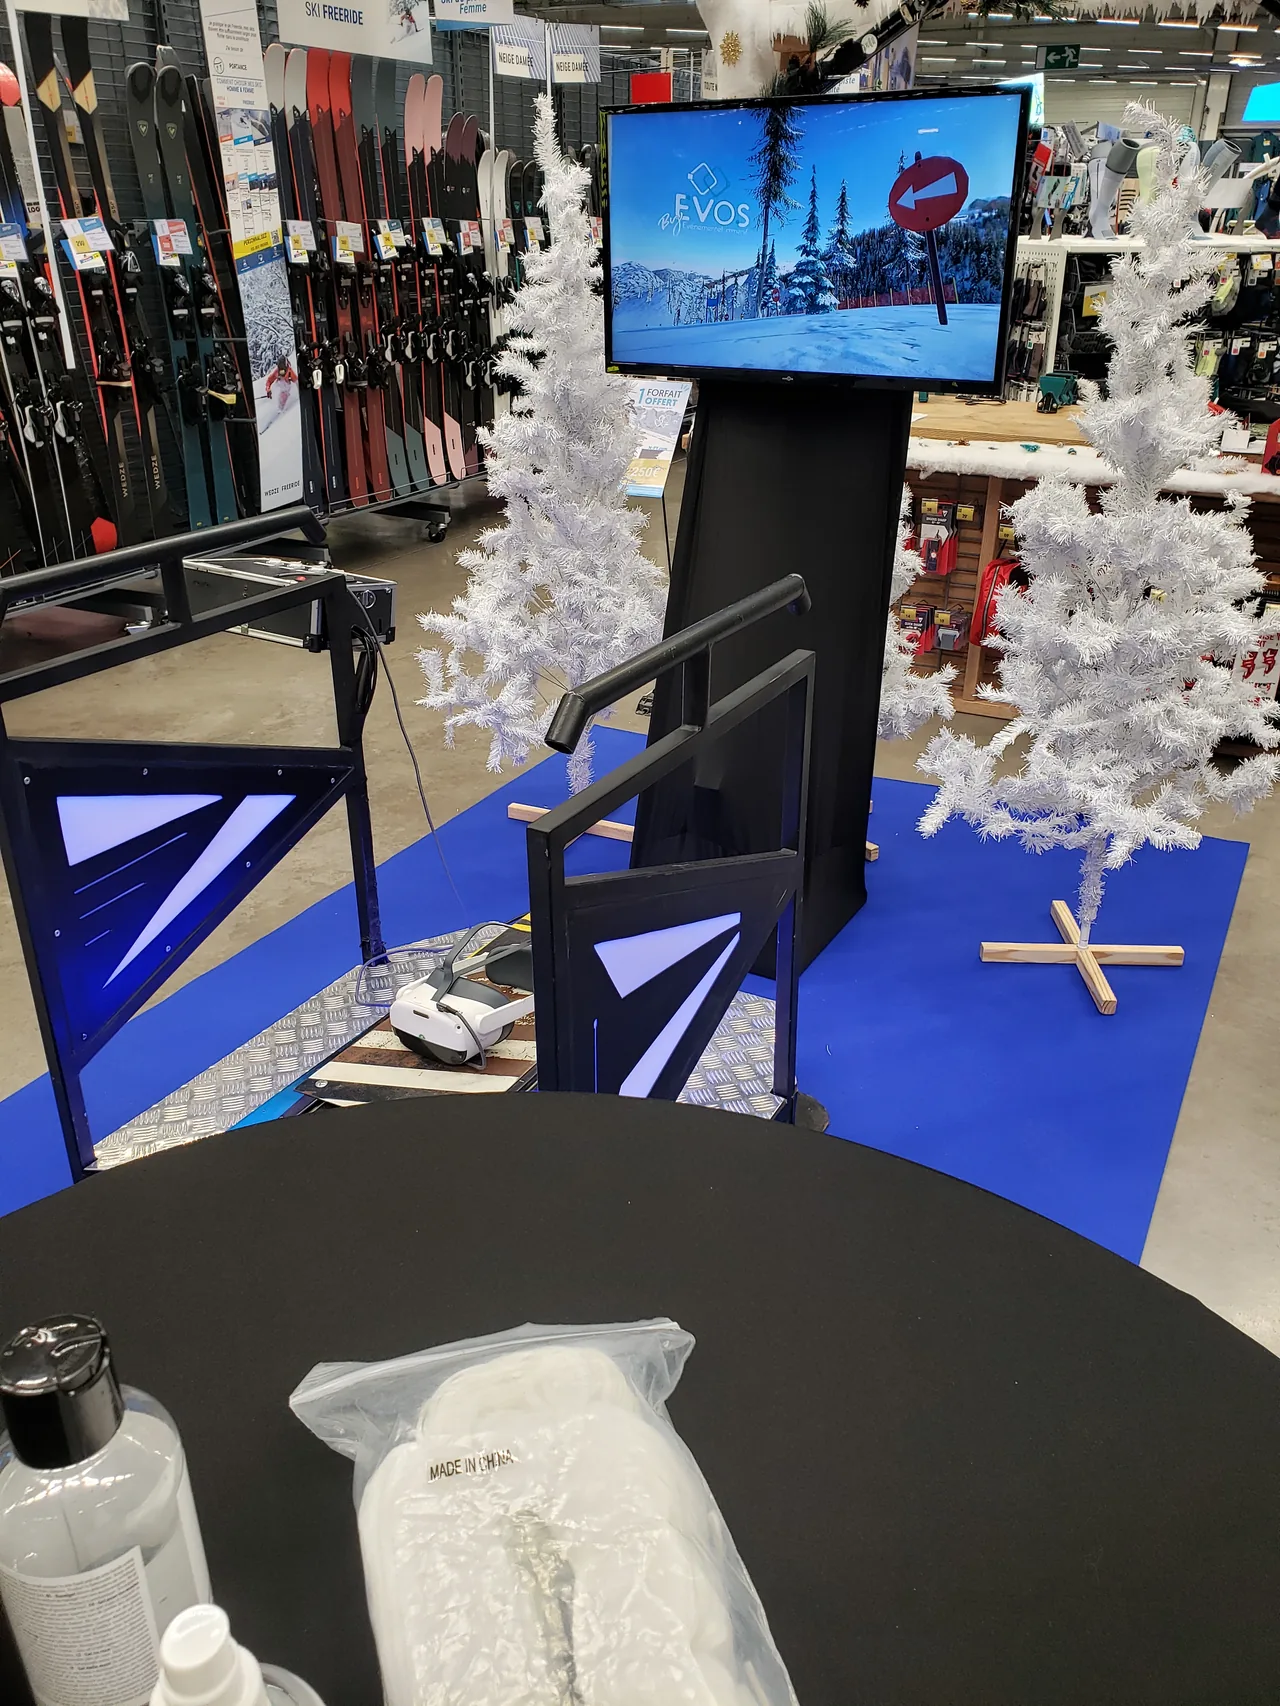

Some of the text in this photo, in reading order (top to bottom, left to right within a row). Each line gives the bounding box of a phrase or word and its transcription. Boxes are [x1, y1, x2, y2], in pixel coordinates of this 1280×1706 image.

[305, 1, 364, 25] SKI FREERIDE
[459, 3, 487, 14] Femme
[498, 51, 515, 64] NEIGE
[556, 61, 571, 72] NEIGE
[675, 193, 750, 228] EVOS
[638, 388, 683, 404] 1 FORFAIT
[645, 397, 678, 406] OFFERT
[118, 461, 128, 498] WEDZE
[150, 454, 161, 490] WEDZE
[430, 1449, 514, 1481] MADE IN CHINA
